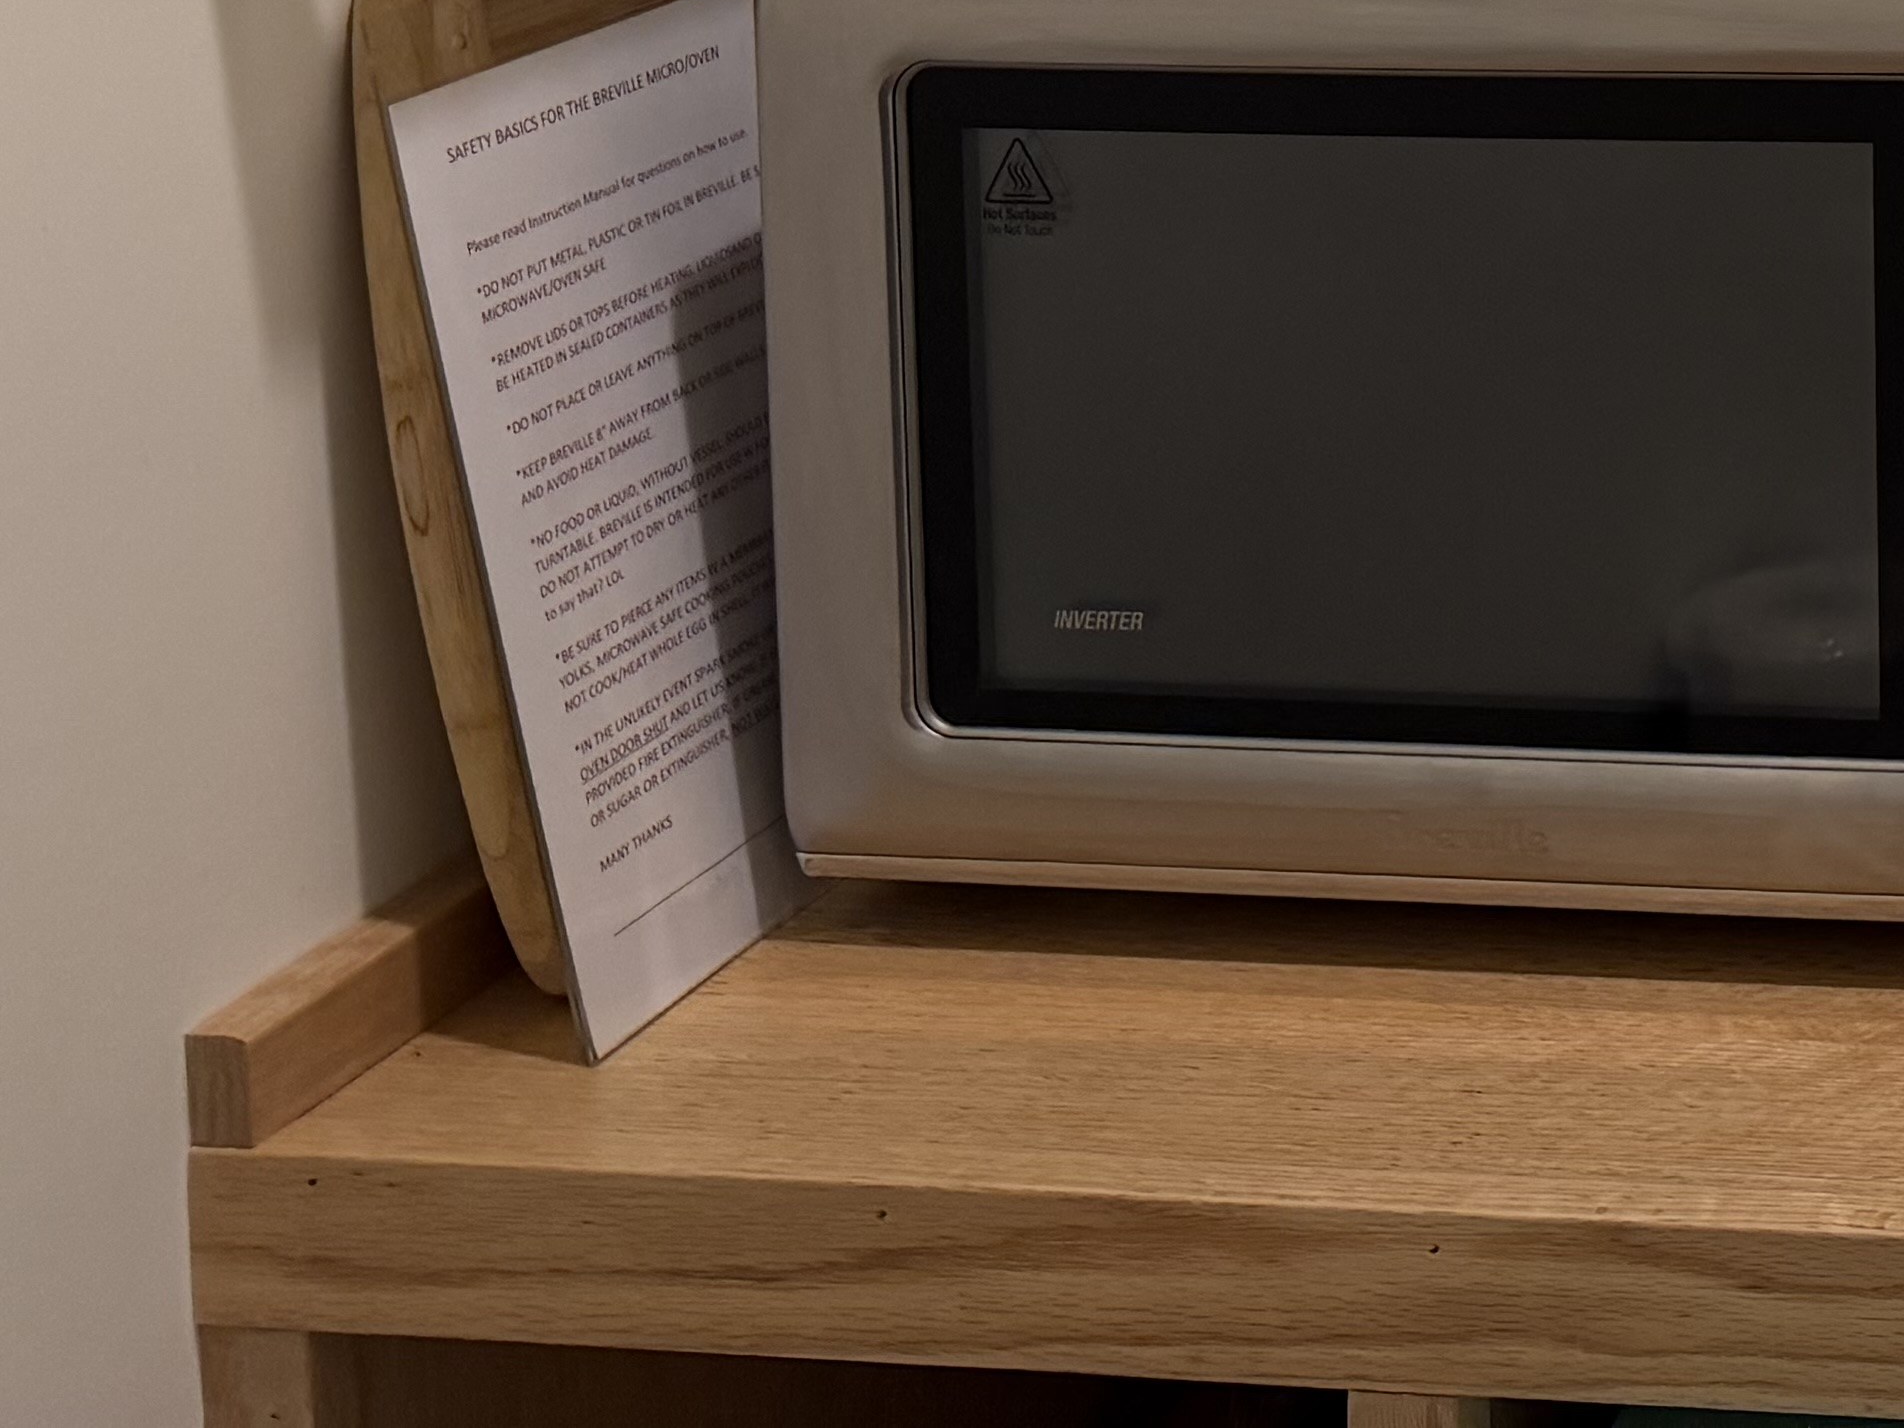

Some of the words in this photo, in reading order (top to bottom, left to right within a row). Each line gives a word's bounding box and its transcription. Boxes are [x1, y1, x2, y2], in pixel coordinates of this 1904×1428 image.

[446, 132, 492, 163] SAFETY
[495, 114, 538, 144] BASICS
[539, 104, 565, 127] FOR
[565, 94, 590, 117] THE
[592, 74, 643, 106] BREVILLE
[645, 44, 719, 85] MICRO/OVEN
[466, 230, 501, 256] Please
[501, 220, 525, 241] read
[528, 196, 581, 230] Instruction
[620, 173, 636, 190] for
[637, 154, 681, 183] questions
[682, 148, 695, 164] on
[696, 139, 715, 158] how
[717, 134, 728, 149] to
[500, 268, 524, 290] NOT
[526, 258, 548, 278] PUT
[588, 223, 626, 250] PLASTIC
[627, 215, 643, 233] OR
[644, 208, 660, 225] TIN
[683, 193, 694, 208] IN
[481, 267, 582, 325] MICROWAVE/OVEN
[582, 256, 606, 279] SAFE
[545, 322, 567, 344] LIDS
[568, 314, 584, 333] OR
[585, 302, 610, 325] TOPS
[611, 284, 649, 313] BEFORE
[496, 375, 510, 393] BE
[511, 354, 554, 385] HEATED
[555, 348, 566, 364] IN
[567, 330, 604, 358] SEALED
[605, 299, 668, 340] CONTAINERS
[669, 292, 682, 308] AS
[531, 404, 554, 426] NOT
[555, 387, 586, 413] PLACE
[588, 379, 602, 397] OR
[603, 363, 634, 389] LEAVE
[548, 431, 594, 466] BREVILLE
[607, 407, 639, 435] AWAY
[640, 392, 669, 418] FROM
[520, 483, 544, 508] AND
[545, 465, 578, 494] AVOID
[580, 450, 606, 476] HEAT
[553, 511, 584, 539] FOOD
[586, 502, 601, 521] OR
[640, 454, 687, 491] WITHOUT
[599, 505, 640, 540] BREVILLE
[643, 498, 653, 515] IS
[653, 469, 703, 509] INTENDED
[540, 578, 557, 600] DO
[558, 565, 580, 589] NOT
[582, 537, 629, 576] ATTEMPT
[630, 528, 644, 548] TO
[645, 517, 665, 539] DRY
[667, 506, 683, 527] OR
[558, 595, 574, 615] say
[605, 565, 625, 588] LOL
[576, 627, 602, 655] SURE
[605, 617, 619, 638] TO
[620, 597, 653, 628] PIERCE
[653, 584, 675, 608] ANY
[1053, 609, 1144, 631] INVERTER
[564, 689, 587, 716] NOT
[588, 651, 648, 701] COOK/HEAT
[648, 629, 683, 663] WHOLE
[685, 615, 706, 640] EGG
[596, 619, 657, 669] MICROWAVE
[659, 604, 683, 630] SAFE
[580, 752, 609, 783] OVEN
[610, 732, 640, 763] DOOR
[642, 714, 668, 742] SHUT
[669, 699, 690, 724] AND
[691, 688, 708, 709] LET
[709, 678, 723, 697] US
[594, 723, 614, 747] THE
[615, 692, 661, 734] UNLIKELY
[662, 672, 692, 703] EVENT
[585, 761, 636, 807] PROVIDED
[638, 746, 660, 771] FIRE
[590, 810, 603, 830] OR
[607, 784, 641, 819] SUGAR
[643, 772, 659, 794] OR
[599, 841, 629, 875] MANY
[632, 811, 672, 851] THANKS
